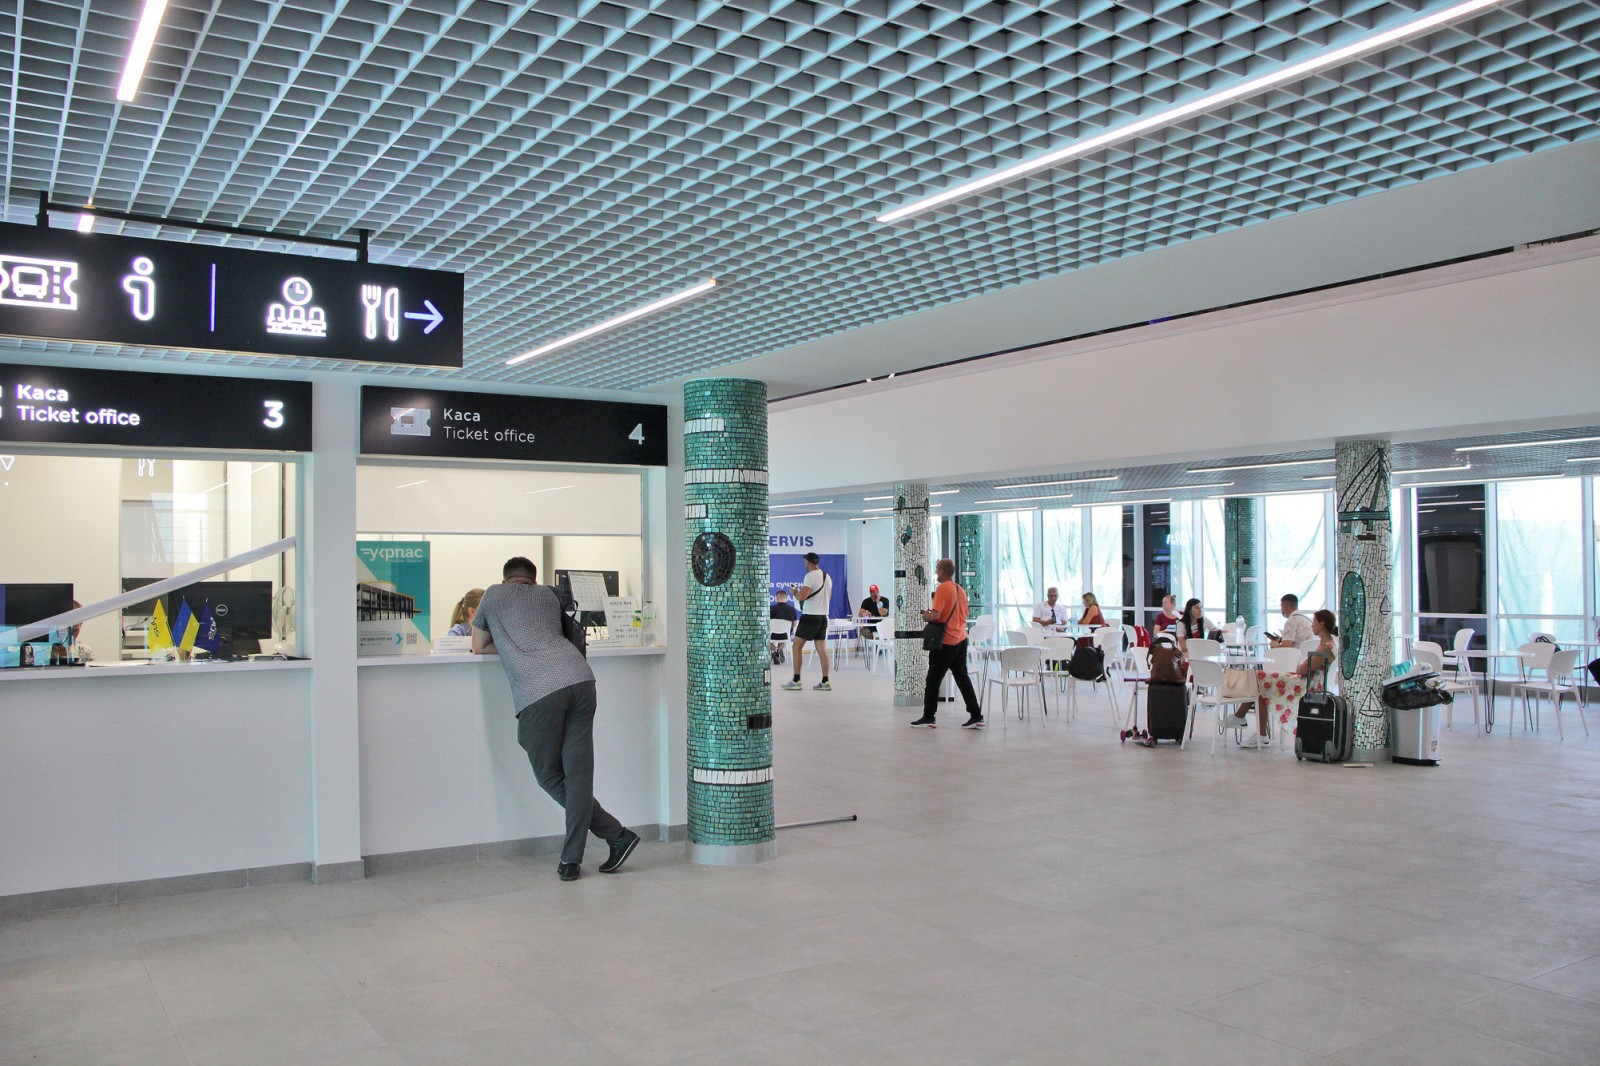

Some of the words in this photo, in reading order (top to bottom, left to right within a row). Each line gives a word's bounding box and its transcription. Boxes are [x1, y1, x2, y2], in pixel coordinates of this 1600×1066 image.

[17, 384, 69, 402] Каса
[17, 404, 80, 424] Ticket
[85, 408, 141, 426] office
[262, 399, 285, 429] 3
[443, 408, 482, 423] Каса
[443, 426, 489, 442] Ticket
[494, 429, 536, 444] office
[628, 423, 646, 445] 4
[769, 535, 813, 546] ERVIS
